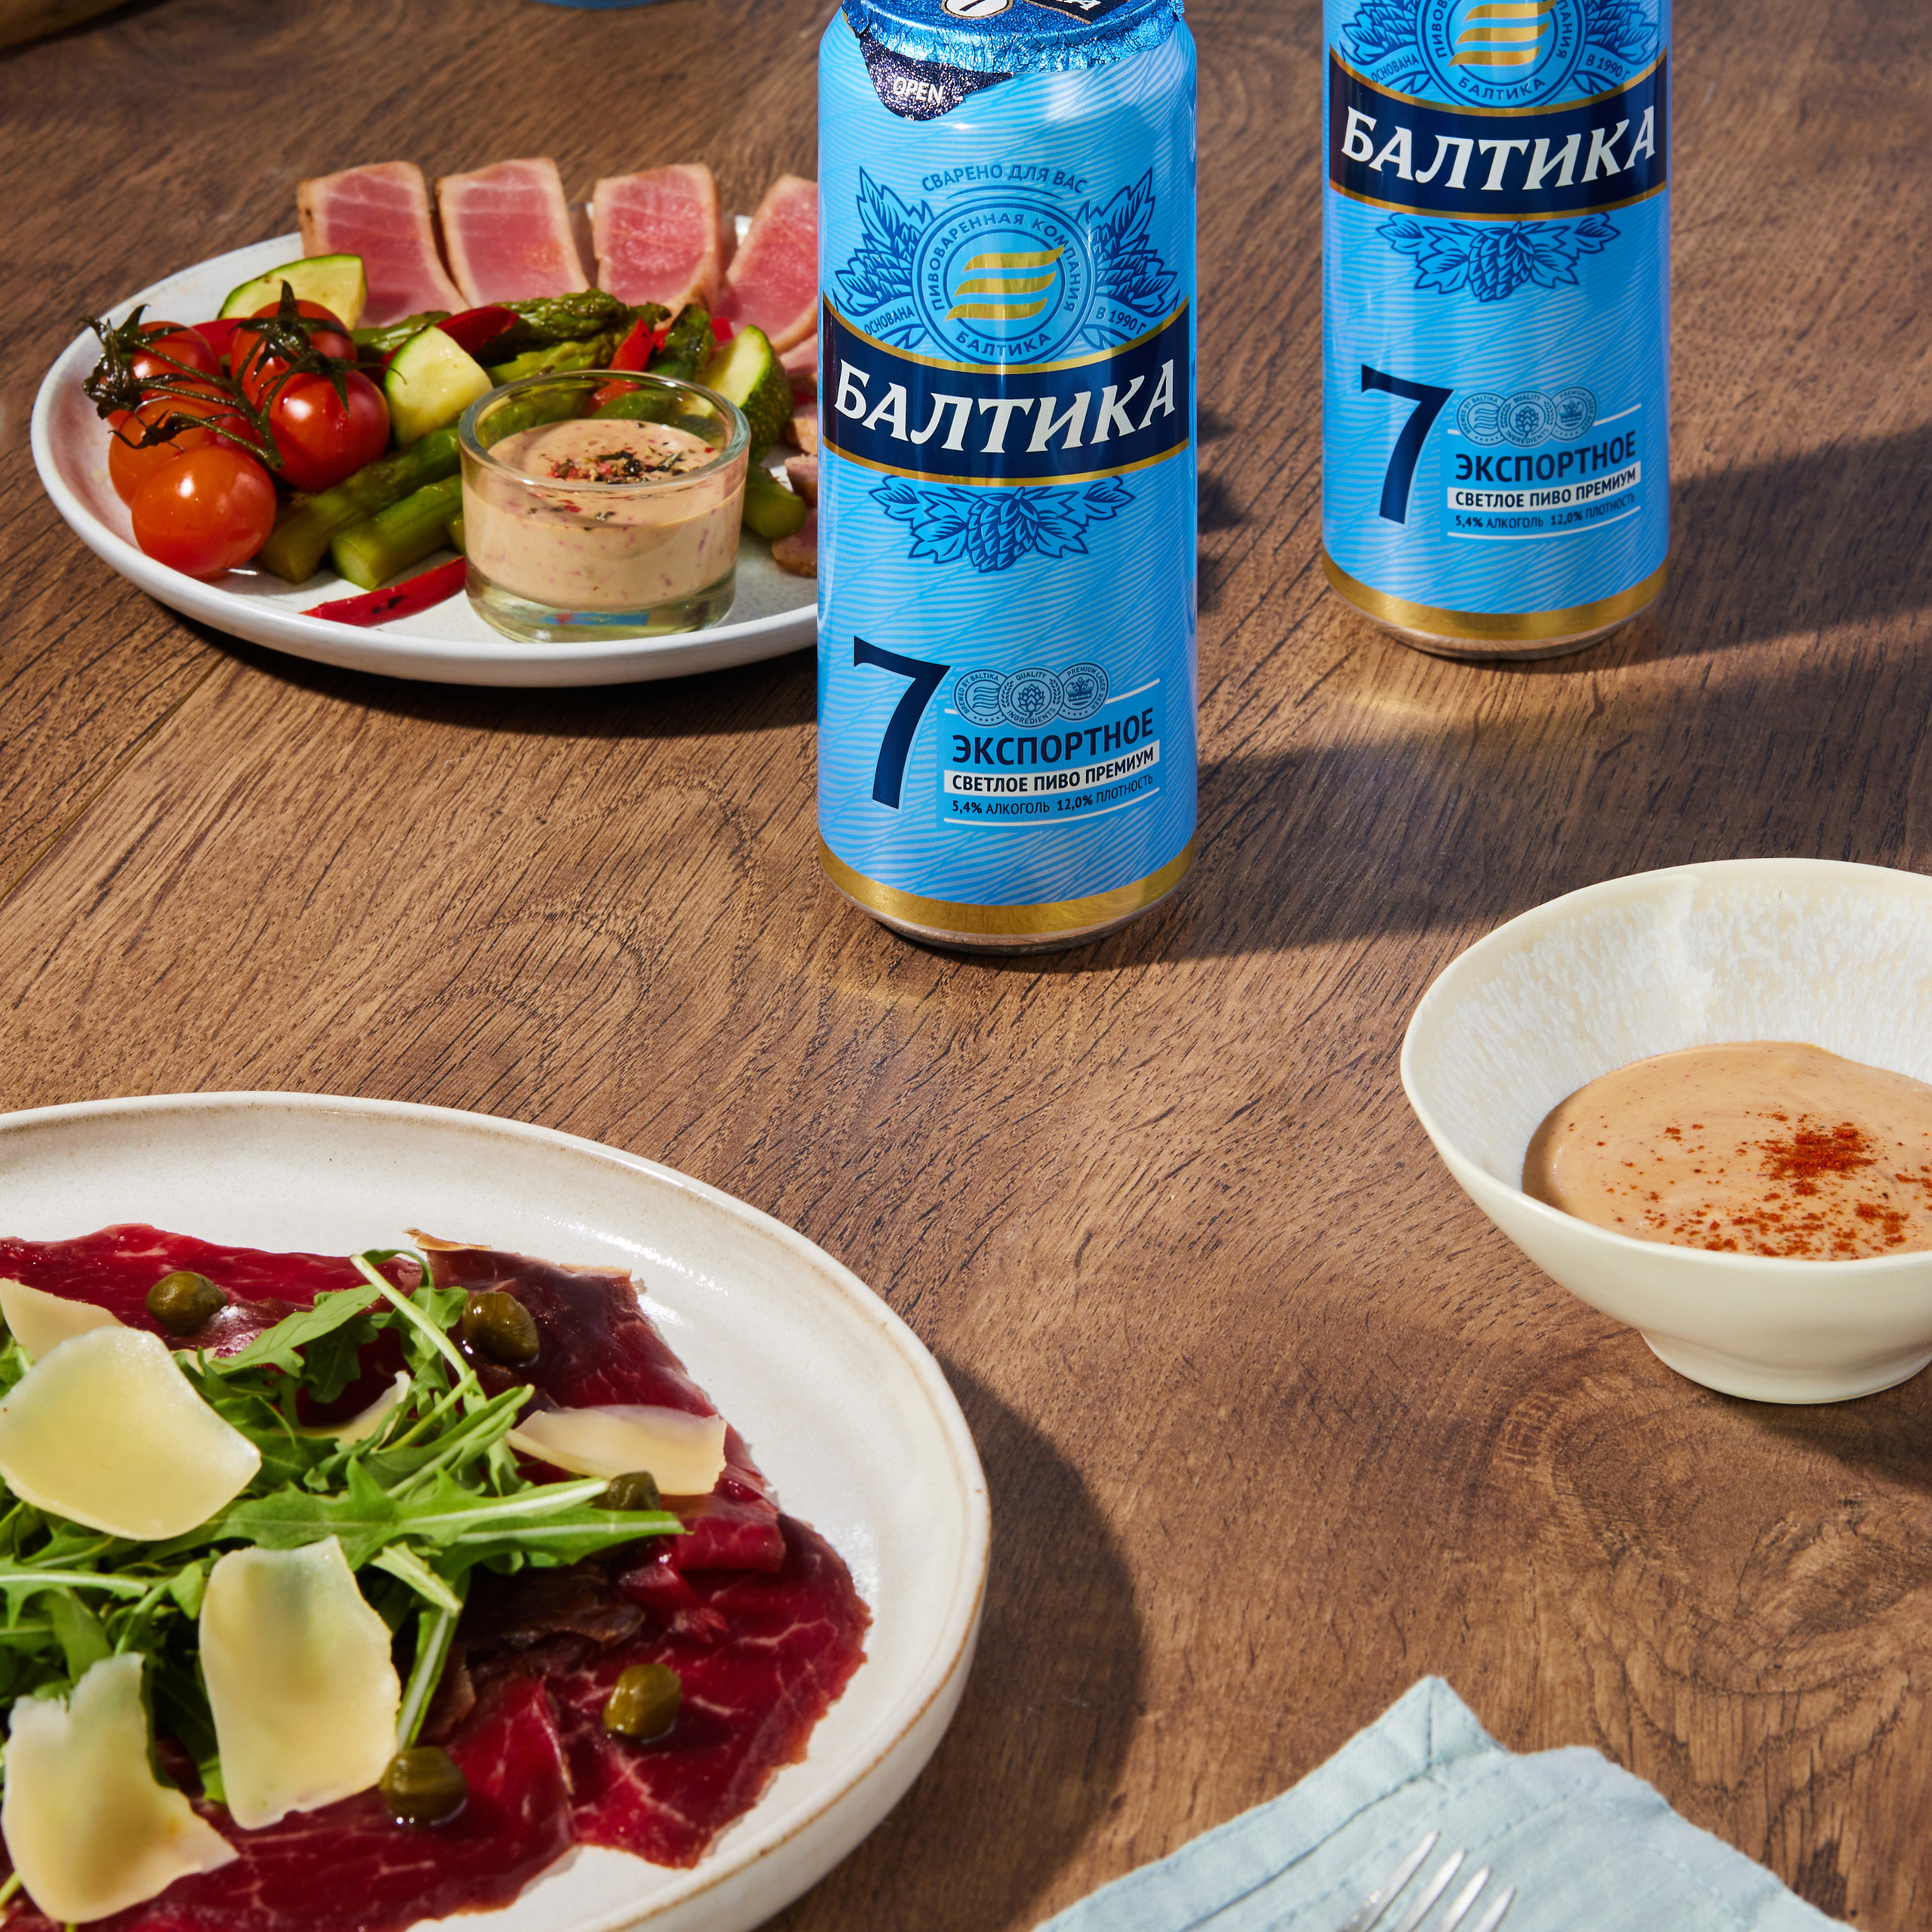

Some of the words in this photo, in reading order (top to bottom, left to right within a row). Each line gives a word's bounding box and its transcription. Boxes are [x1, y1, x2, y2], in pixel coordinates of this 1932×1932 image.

[1556, 0, 1573, 59] ПАНИЯ
[1371, 54, 1420, 83] ОСНОВАНА
[1586, 54, 1594, 66] В
[1596, 57, 1624, 79] 1990
[893, 76, 945, 106] OPEN
[1458, 77, 1546, 100] БАЛТИКА
[1341, 105, 1657, 191] БАЛТИКА
[921, 165, 1003, 192] СВАРЕНО
[1008, 165, 1050, 181] ДЛЯ
[1053, 170, 1087, 194] ВАС
[928, 213, 1025, 311] ПИВОВАРЕННАЯ
[1032, 218, 1081, 312] КОМПАНИЯ
[866, 305, 915, 336] ОСНОВАНА
[1096, 306, 1105, 320] В
[1108, 308, 1137, 331] 1990
[956, 332, 1053, 357] БАЛТИКА
[835, 358, 1177, 453] БАЛТИКА
[1472, 395, 1497, 404] BALTIKA
[1513, 394, 1541, 402] QUALITY
[1559, 390, 1586, 399] PREMIUM
[1361, 364, 1454, 525] 7
[1505, 429, 1549, 444] INGREDIENTS
[1455, 430, 1635, 482] ЭКСПОРТНОЕ
[1456, 491, 1524, 507] СВЕТЛОЕ
[1530, 489, 1571, 506] ПИВО
[1576, 467, 1636, 500] ПРЕМИУМ
[1455, 515, 1483, 528] 5,4%
[1486, 518, 1544, 528] АЛКОГОЛЬ
[1551, 511, 1583, 526] 12,0%
[1586, 493, 1635, 518] ПЛОТНОСТЬ
[962, 678, 970, 688] BY
[971, 672, 998, 681] BALTIKA
[1016, 672, 1048, 681] QUALITY
[1067, 666, 1097, 676] PREMIUM
[1096, 670, 1106, 691] LAGER
[957, 688, 970, 714] BREWED
[1007, 707, 1056, 724] INGREDIENTS
[1091, 692, 1104, 710] BEER
[854, 635, 952, 810] 7
[952, 707, 1154, 765] ЭКСПОРТНОЕ
[952, 774, 1027, 792] СВЕТЛОЕ
[1033, 772, 1081, 791] ПИВО
[1085, 746, 1154, 783] ПРЕМИУМ
[952, 800, 983, 814] 5,4%
[986, 802, 1050, 814] АЛКОГОЛЬ
[1057, 796, 1094, 811] 12,0%
[1097, 774, 1154, 804] ПЛОТНОСТЬ
